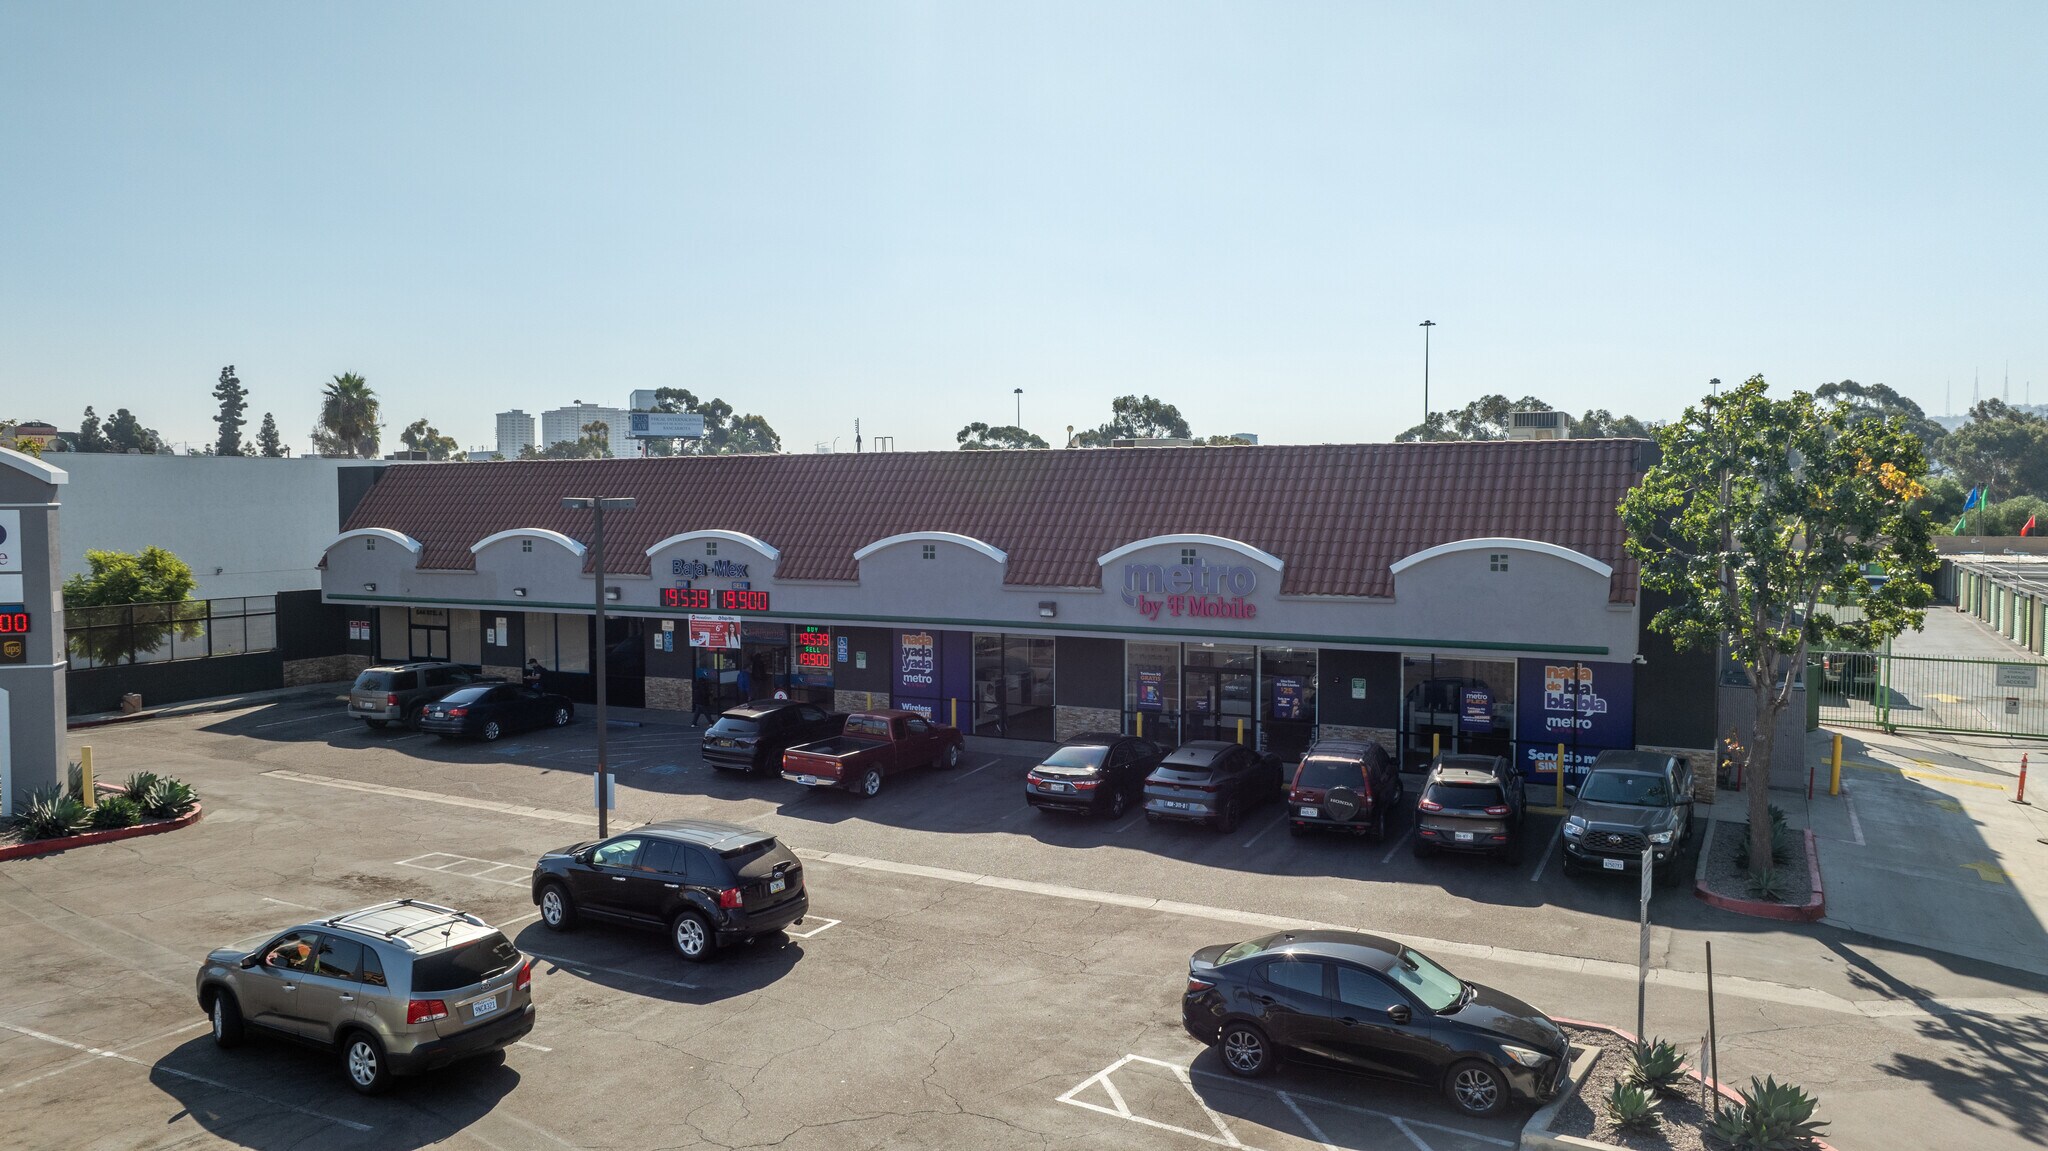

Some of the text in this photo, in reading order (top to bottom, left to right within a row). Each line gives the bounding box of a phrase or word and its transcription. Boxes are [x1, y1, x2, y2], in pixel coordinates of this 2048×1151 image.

[672, 559, 749, 579] Baja-Mex
[1121, 558, 1256, 600] metro
[665, 589, 708, 608] 19.539
[723, 590, 767, 610] 19.900
[1138, 595, 1163, 620] by
[1188, 596, 1256, 619] Mobile
[800, 633, 829, 646] 19.539
[902, 632, 932, 646] nada
[800, 653, 829, 666] 19.900
[903, 646, 932, 659] yada
[902, 658, 932, 672] yada
[1546, 664, 1592, 680] nada
[902, 674, 932, 685] metro
[1546, 680, 1592, 695] de ba
[901, 702, 932, 712] Wireless
[1546, 716, 1592, 731] metro
[1528, 748, 1582, 763] Servcio
[1330, 798, 1354, 807] HONDA
